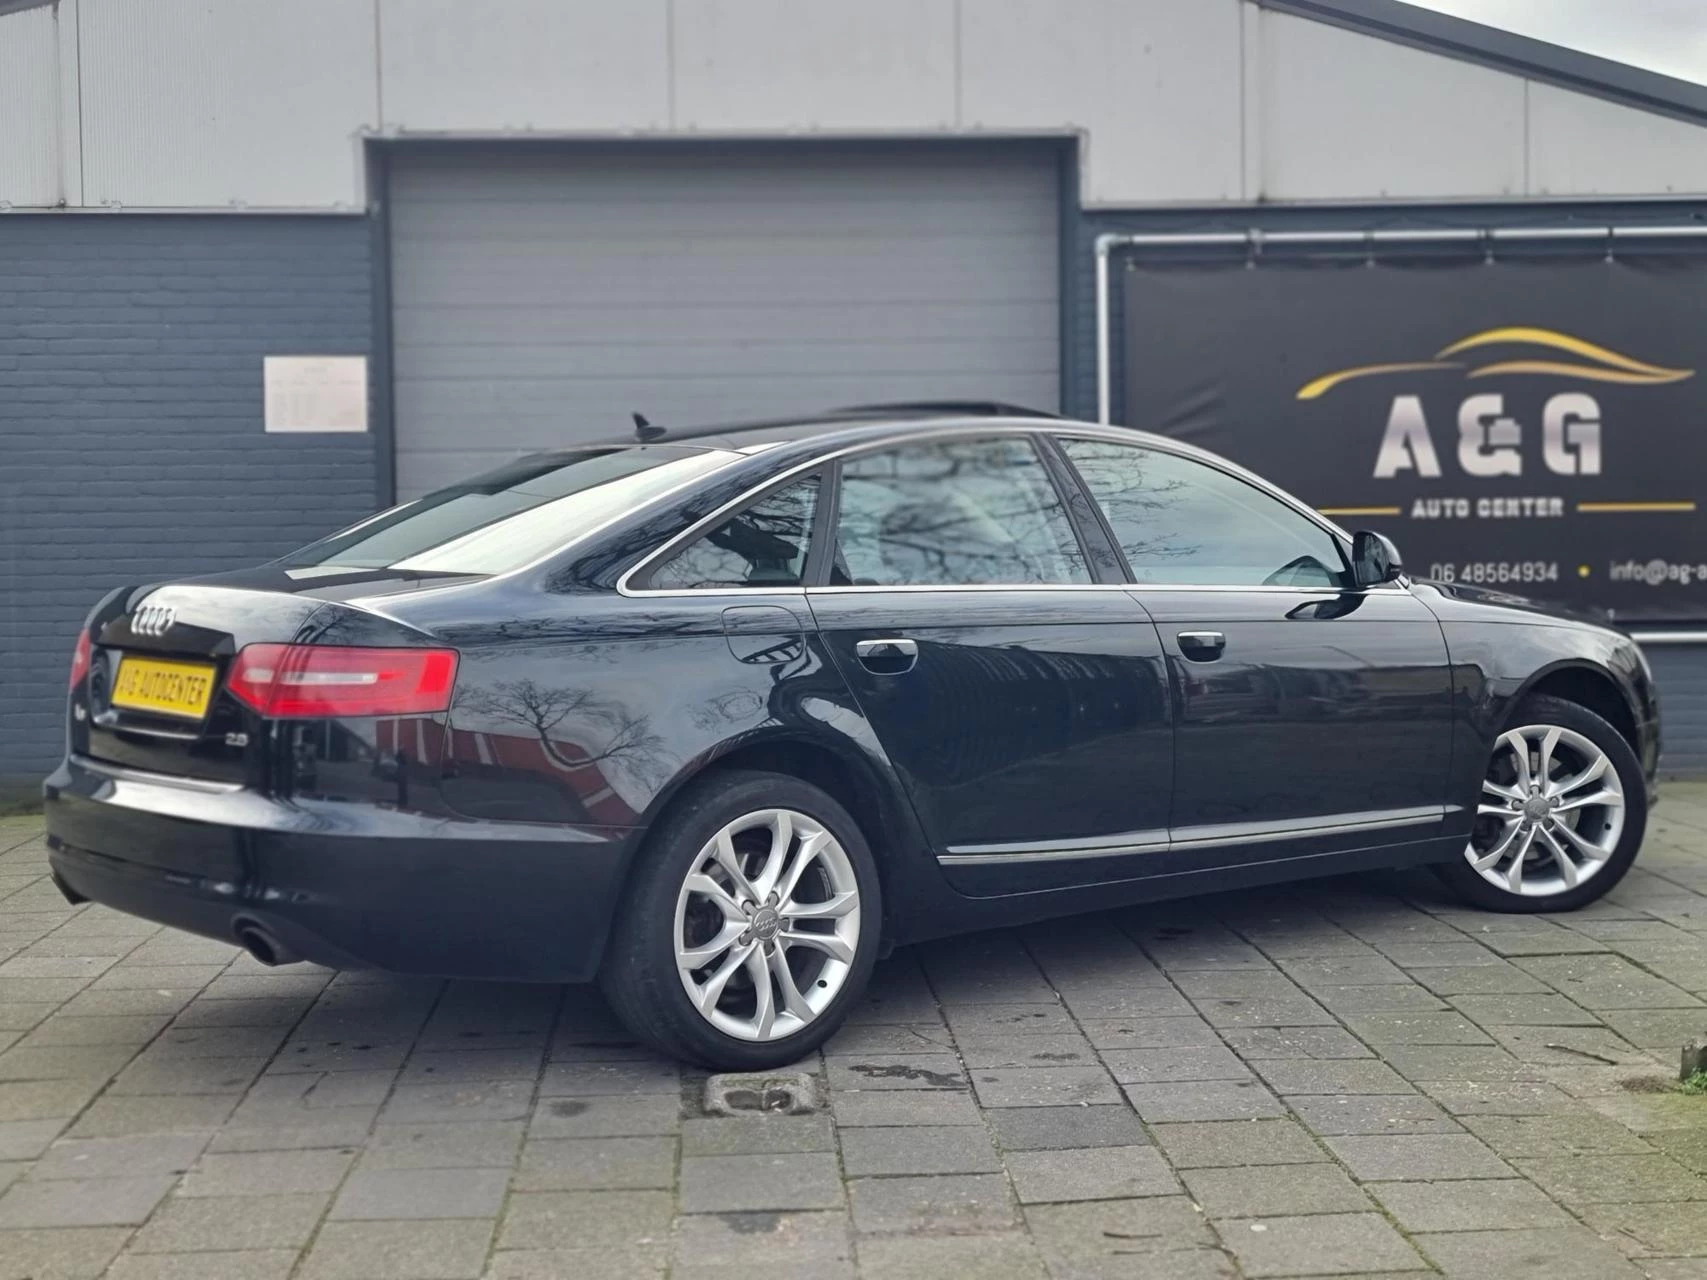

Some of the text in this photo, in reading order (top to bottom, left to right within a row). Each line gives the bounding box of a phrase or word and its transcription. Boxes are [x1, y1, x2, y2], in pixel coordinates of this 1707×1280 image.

[1411, 497, 1564, 519] AUTO CENTER
[1430, 561, 1559, 583] 06 48564934
